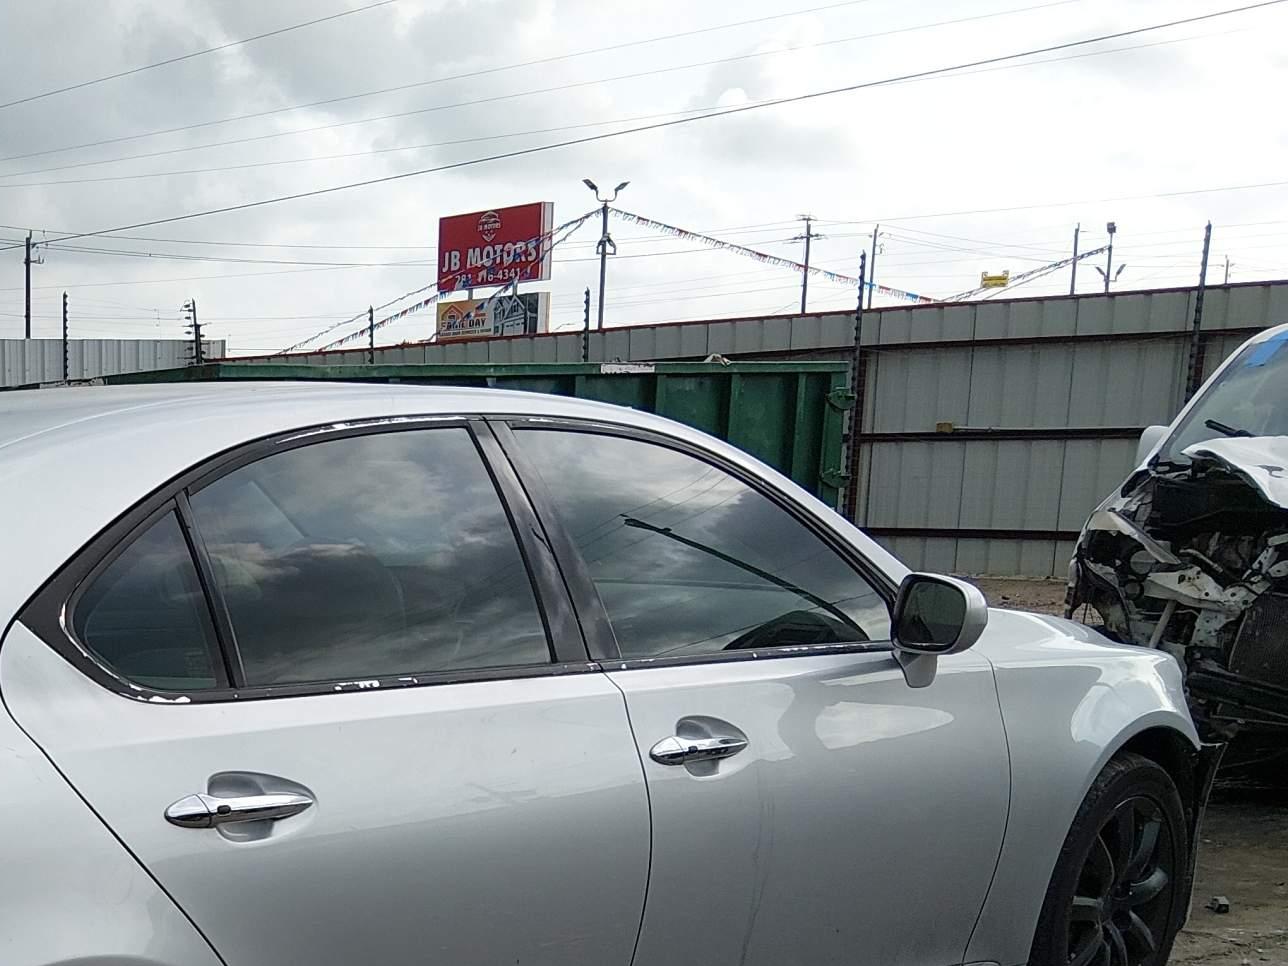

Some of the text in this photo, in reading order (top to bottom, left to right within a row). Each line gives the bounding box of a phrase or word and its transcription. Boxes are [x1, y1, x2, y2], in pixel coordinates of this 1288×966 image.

[442, 241, 537, 273] JB MOTORS
[468, 318, 487, 329] DAY
